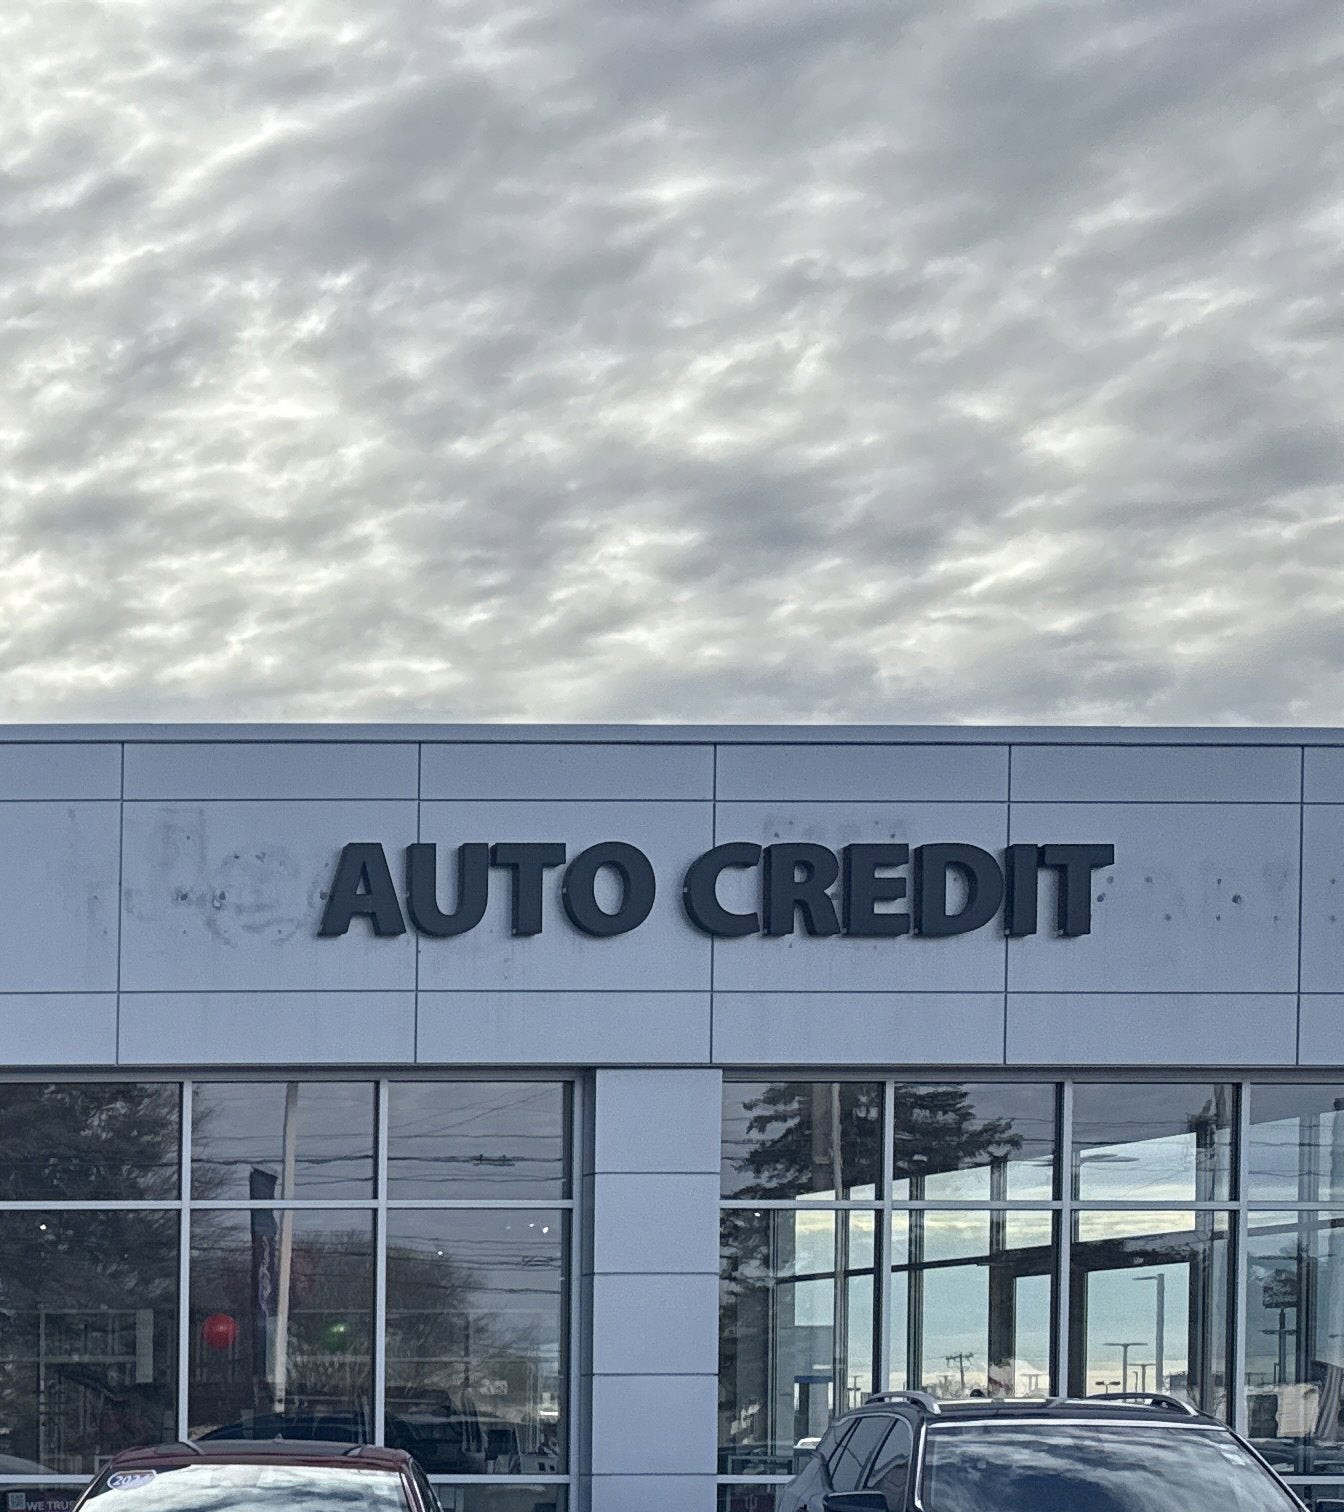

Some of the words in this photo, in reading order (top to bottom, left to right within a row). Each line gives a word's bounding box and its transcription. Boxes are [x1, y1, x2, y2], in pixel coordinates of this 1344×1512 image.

[316, 842, 658, 938] AUTO
[683, 842, 1115, 938] CREDIT
[26, 1501, 45, 1511] WE
